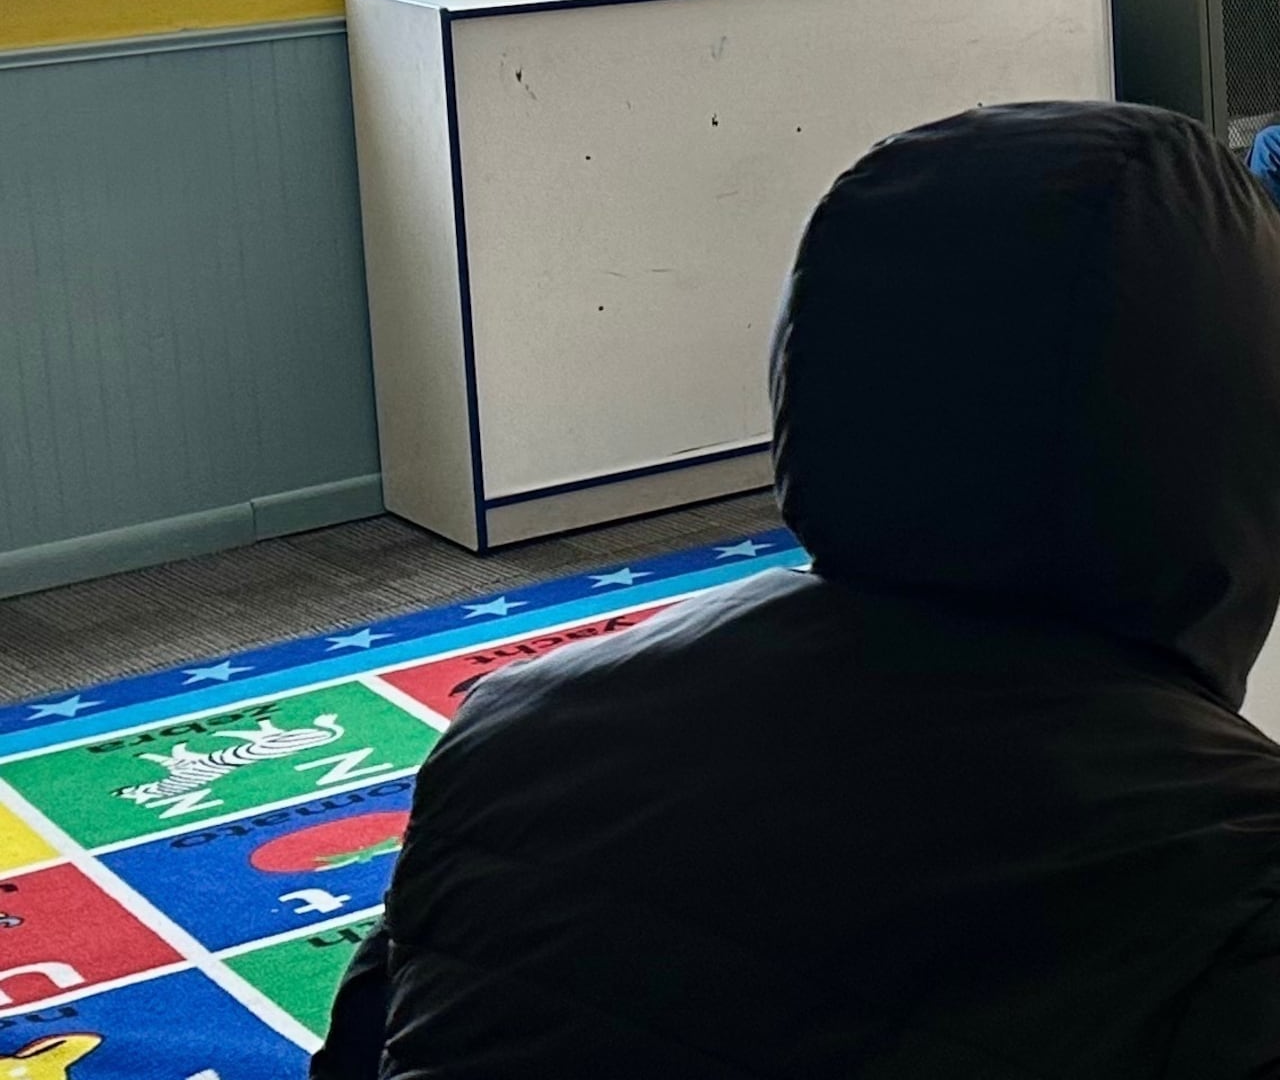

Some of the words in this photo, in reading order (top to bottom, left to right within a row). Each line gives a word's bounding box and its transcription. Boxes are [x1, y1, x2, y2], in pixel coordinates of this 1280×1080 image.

[463, 613, 636, 668] yacht
[84, 702, 283, 757] zebra
[294, 746, 394, 790] Z
[170, 780, 411, 851] omato
[278, 886, 352, 917] t
